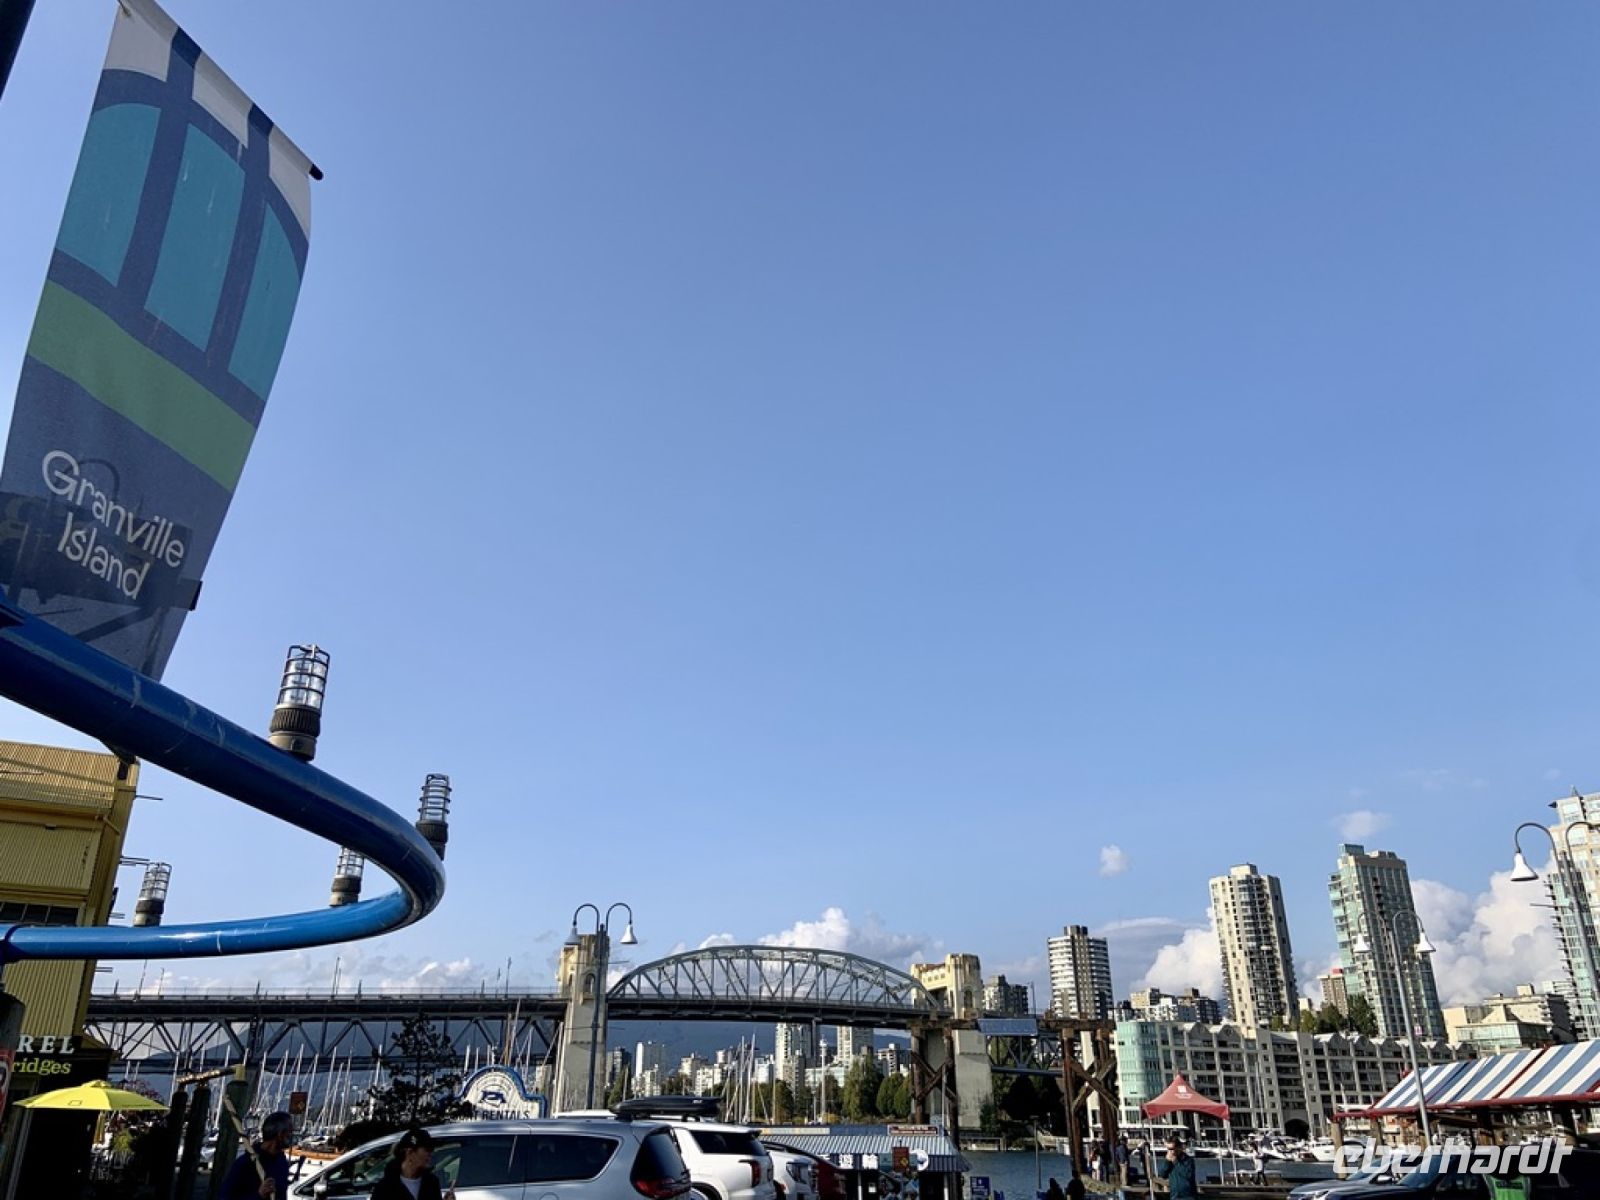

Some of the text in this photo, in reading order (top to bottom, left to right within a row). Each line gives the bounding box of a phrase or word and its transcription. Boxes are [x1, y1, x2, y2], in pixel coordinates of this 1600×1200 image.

[42, 450, 185, 567] Granville
[58, 512, 149, 599] Island
[482, 1110, 530, 1120] RENTALS
